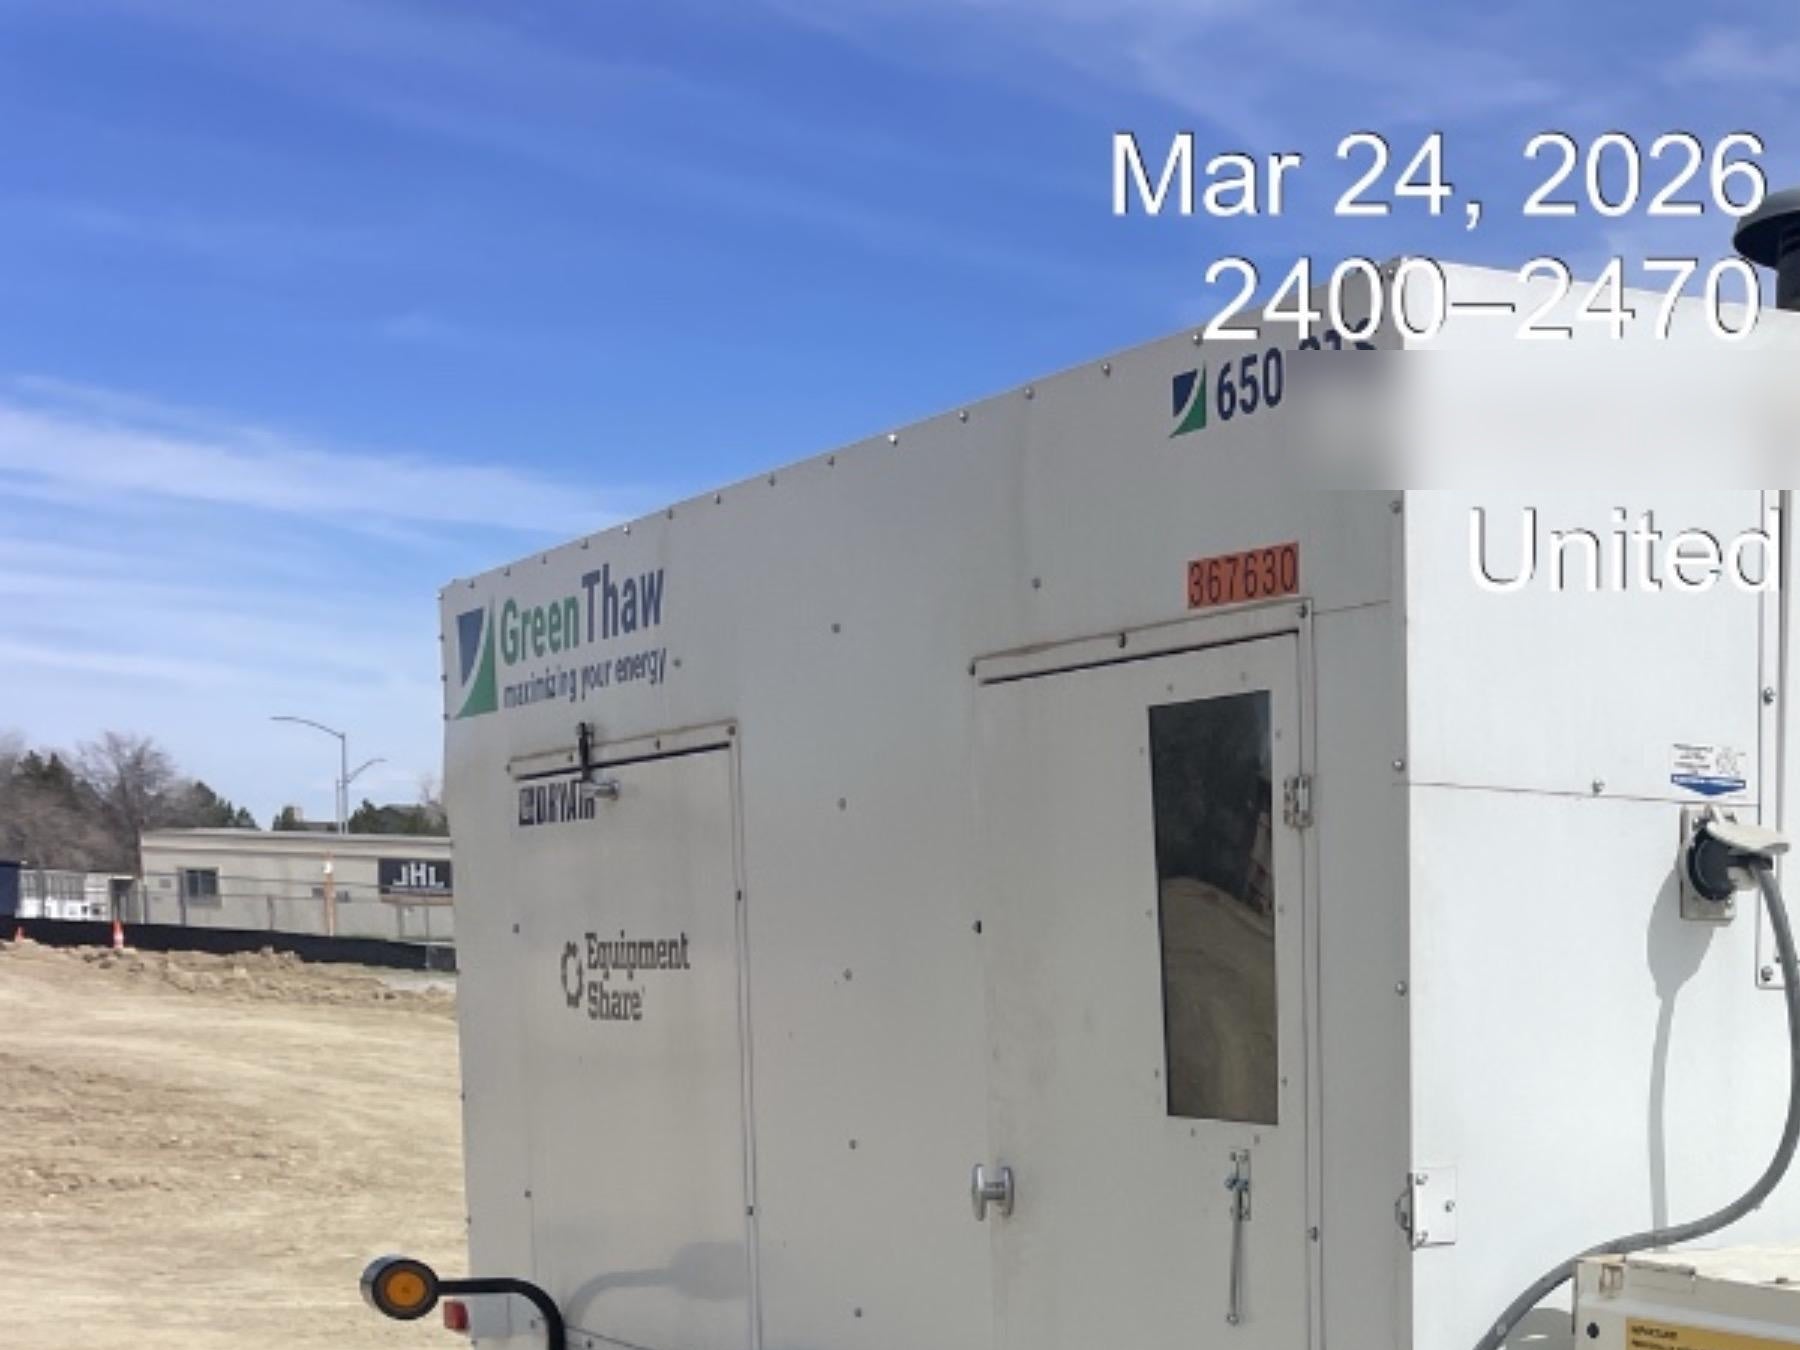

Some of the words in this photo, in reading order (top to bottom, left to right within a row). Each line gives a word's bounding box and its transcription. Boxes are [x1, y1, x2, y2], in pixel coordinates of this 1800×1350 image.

[1216, 346, 1284, 421] 650
[1189, 545, 1297, 607] 367630
[504, 664, 577, 709] maximizing
[580, 658, 613, 701] your
[615, 647, 667, 686] energy
[391, 861, 445, 890] JHL
[584, 928, 691, 982] Equipment
[587, 980, 643, 1021] Share
